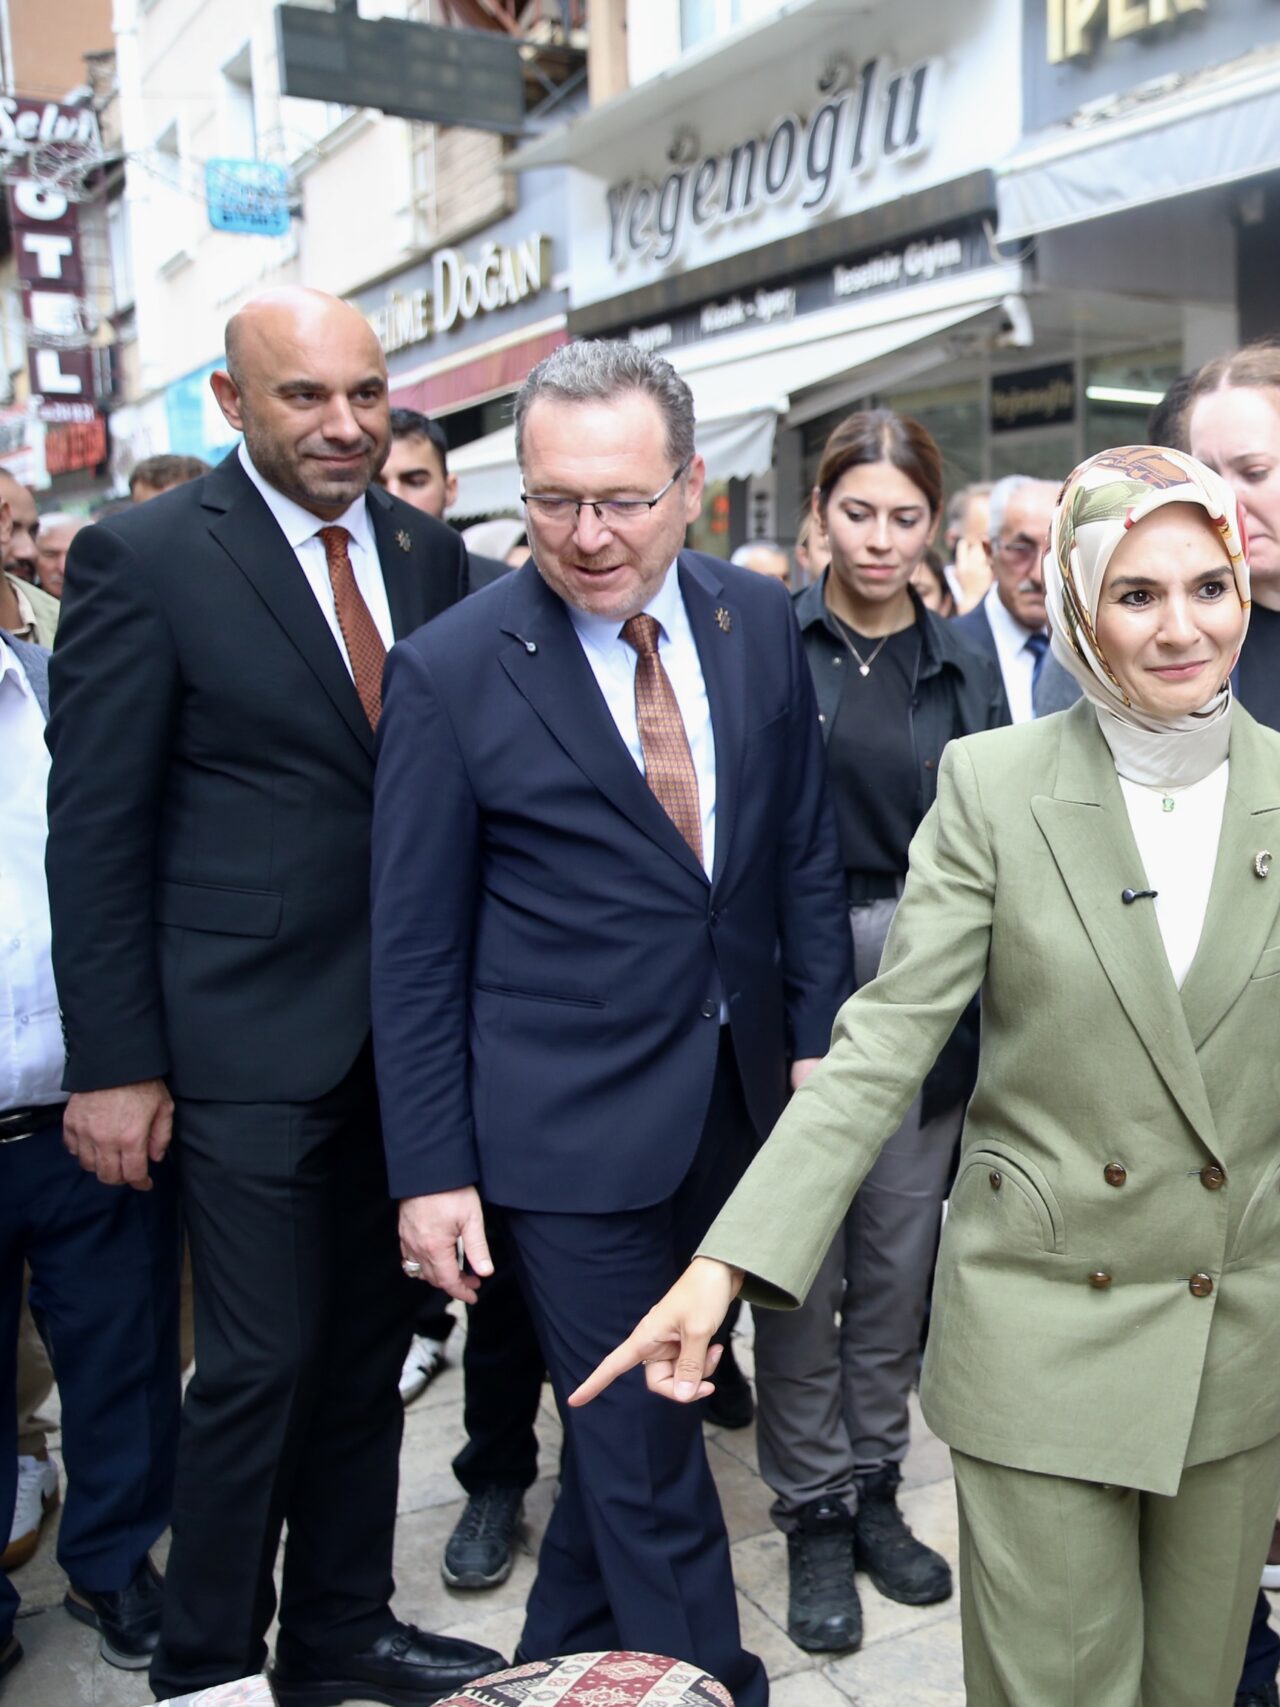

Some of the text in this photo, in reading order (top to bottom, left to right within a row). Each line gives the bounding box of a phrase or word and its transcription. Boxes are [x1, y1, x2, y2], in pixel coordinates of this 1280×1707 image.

[604, 54, 932, 264] Yeğenoğlu
[14, 180, 84, 396] OTEL
[433, 232, 542, 332] DOĞAN
